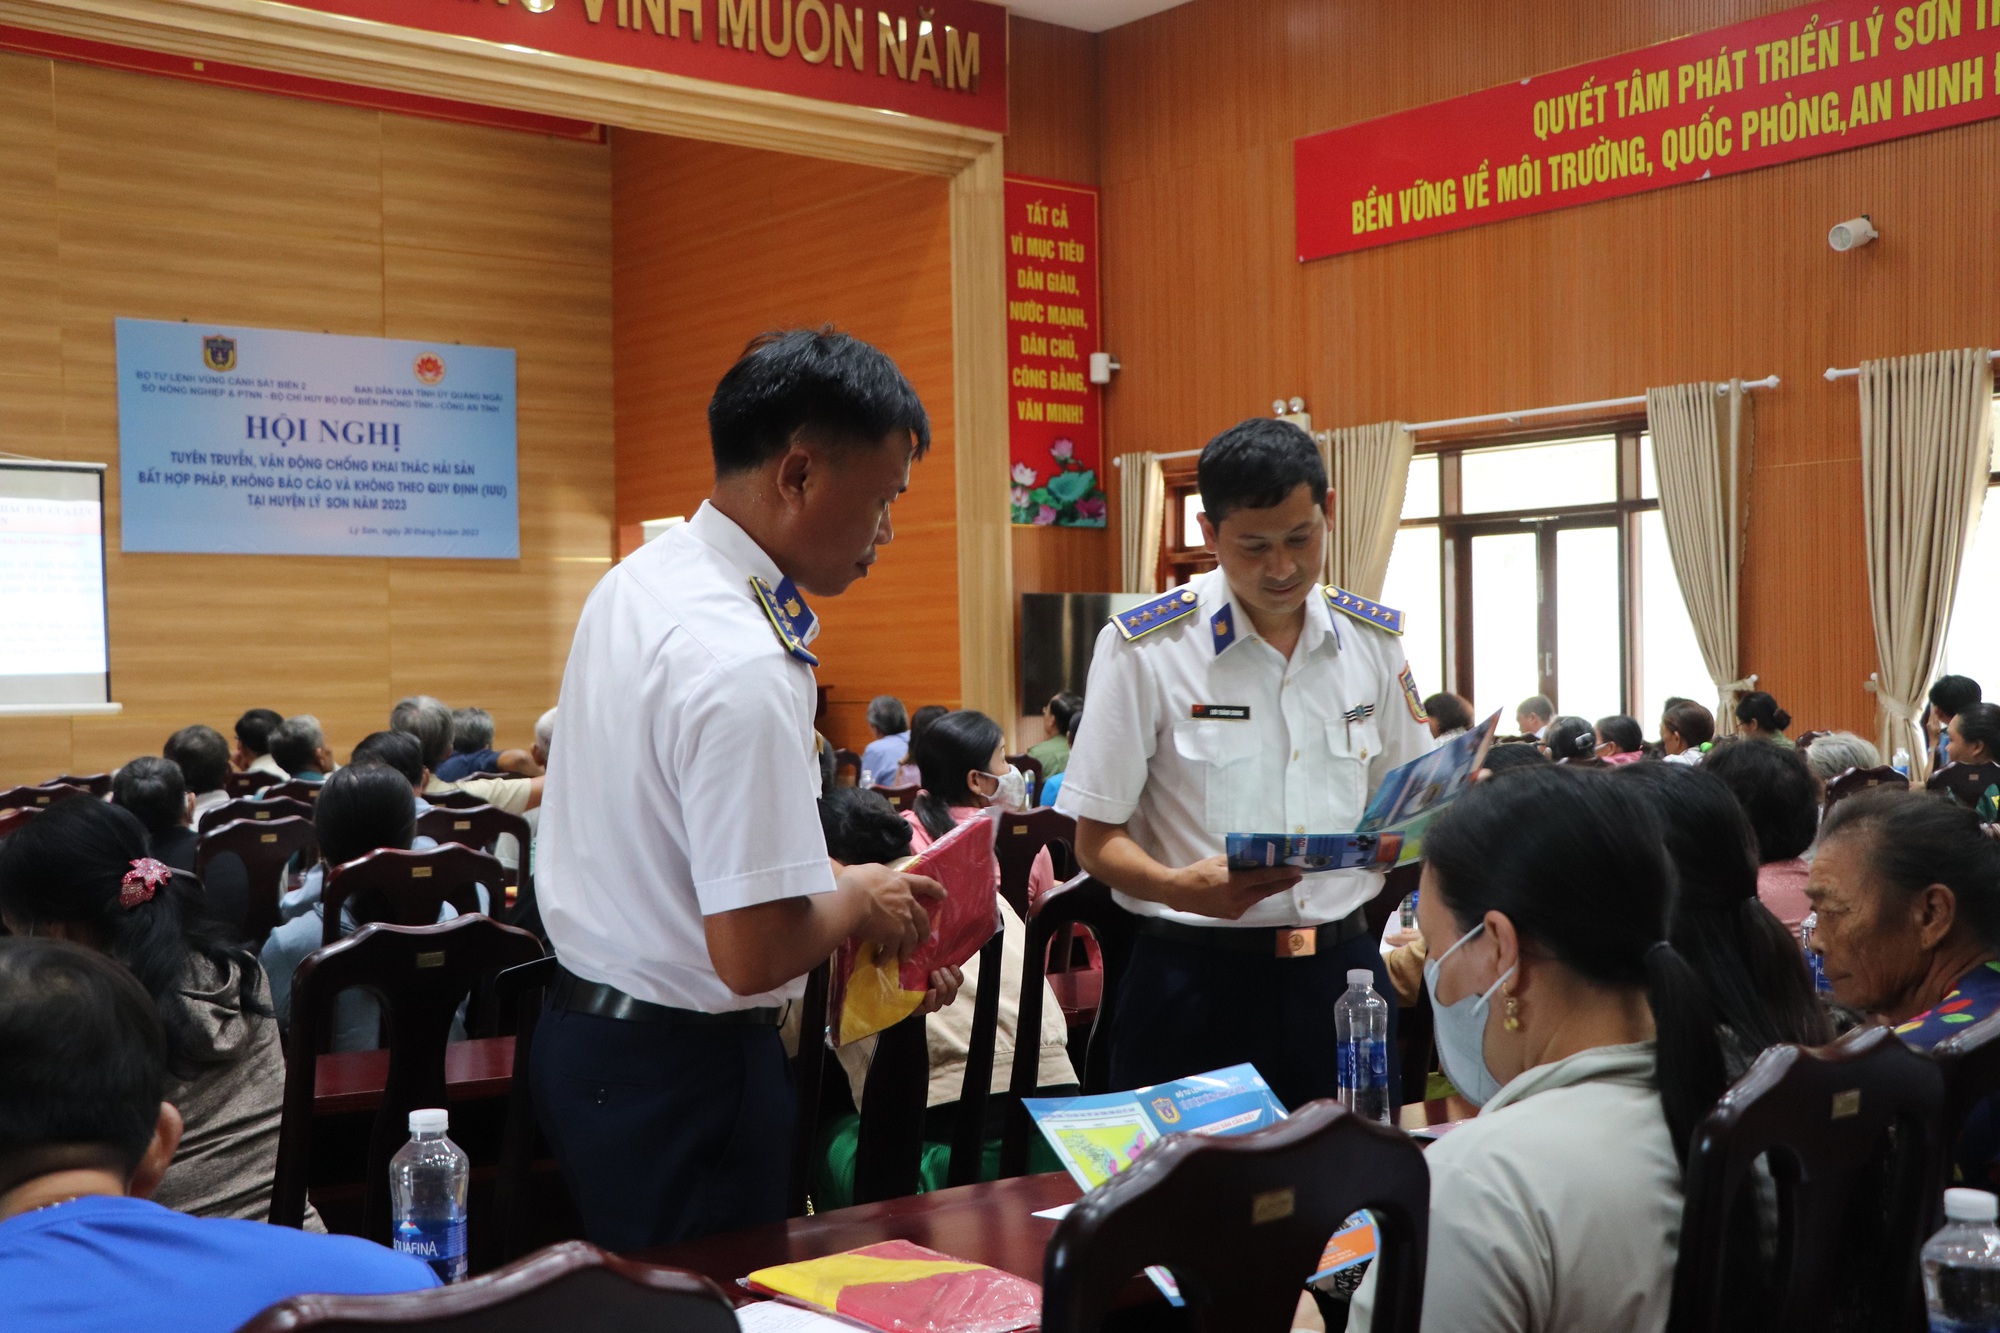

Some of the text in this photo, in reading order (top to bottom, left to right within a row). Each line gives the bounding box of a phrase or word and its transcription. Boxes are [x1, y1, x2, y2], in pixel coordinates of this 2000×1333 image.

[878, 6, 980, 94] NĂM
[1534, 76, 1607, 141] QUYẾT
[1615, 68, 1669, 118] TÂM
[1678, 46, 1747, 104] PHÁT
[1755, 14, 1839, 84] TRIỂN
[1850, 6, 1884, 62] LÝ
[1894, 0, 1960, 52] SƠN
[1352, 186, 1393, 235] BỀN
[1399, 179, 1456, 224] VỮNG
[1463, 159, 1489, 210] VỀ
[1497, 154, 1541, 204] MÔI
[1548, 136, 1653, 192] TRƯỜNG,
[1662, 106, 1732, 171] QUỐC
[1903, 56, 1983, 116] NINH
[1026, 200, 1068, 229] TẤT CẢ
[1011, 232, 1085, 263] VÌ MỤC TIÊU
[1018, 266, 1079, 297] DÂN GIÀU,
[1010, 300, 1088, 330] NƯỚC MẠNH,
[1021, 332, 1079, 360] DÂN CHỦ,
[1013, 364, 1088, 394] CÔNG BẰNG,
[1018, 398, 1084, 424] VĂN MINH!
[247, 413, 401, 452] HỘI NGHỊ
[170, 450, 207, 464] TUYÊN
[260, 453, 285, 471] VẬN
[288, 454, 322, 472] ĐỘNG
[326, 456, 368, 471] CHỐNG
[372, 460, 398, 473] KHAI
[401, 459, 430, 474] THÁC
[139, 467, 161, 484] BẤT
[165, 472, 190, 487] HỢP
[232, 472, 275, 488] KHÔNG
[279, 474, 303, 489] BÁO
[306, 476, 332, 490] CÁO
[336, 476, 351, 491] VÀ
[355, 477, 395, 492] KHÔNG
[398, 481, 424, 493] THEO
[428, 482, 450, 494] QUY
[453, 483, 478, 497] ĐỊNH
[481, 483, 508, 499] (IUU)
[248, 493, 407, 510] TẠI HUYỆN LÝ SƠN NĂM 2023
